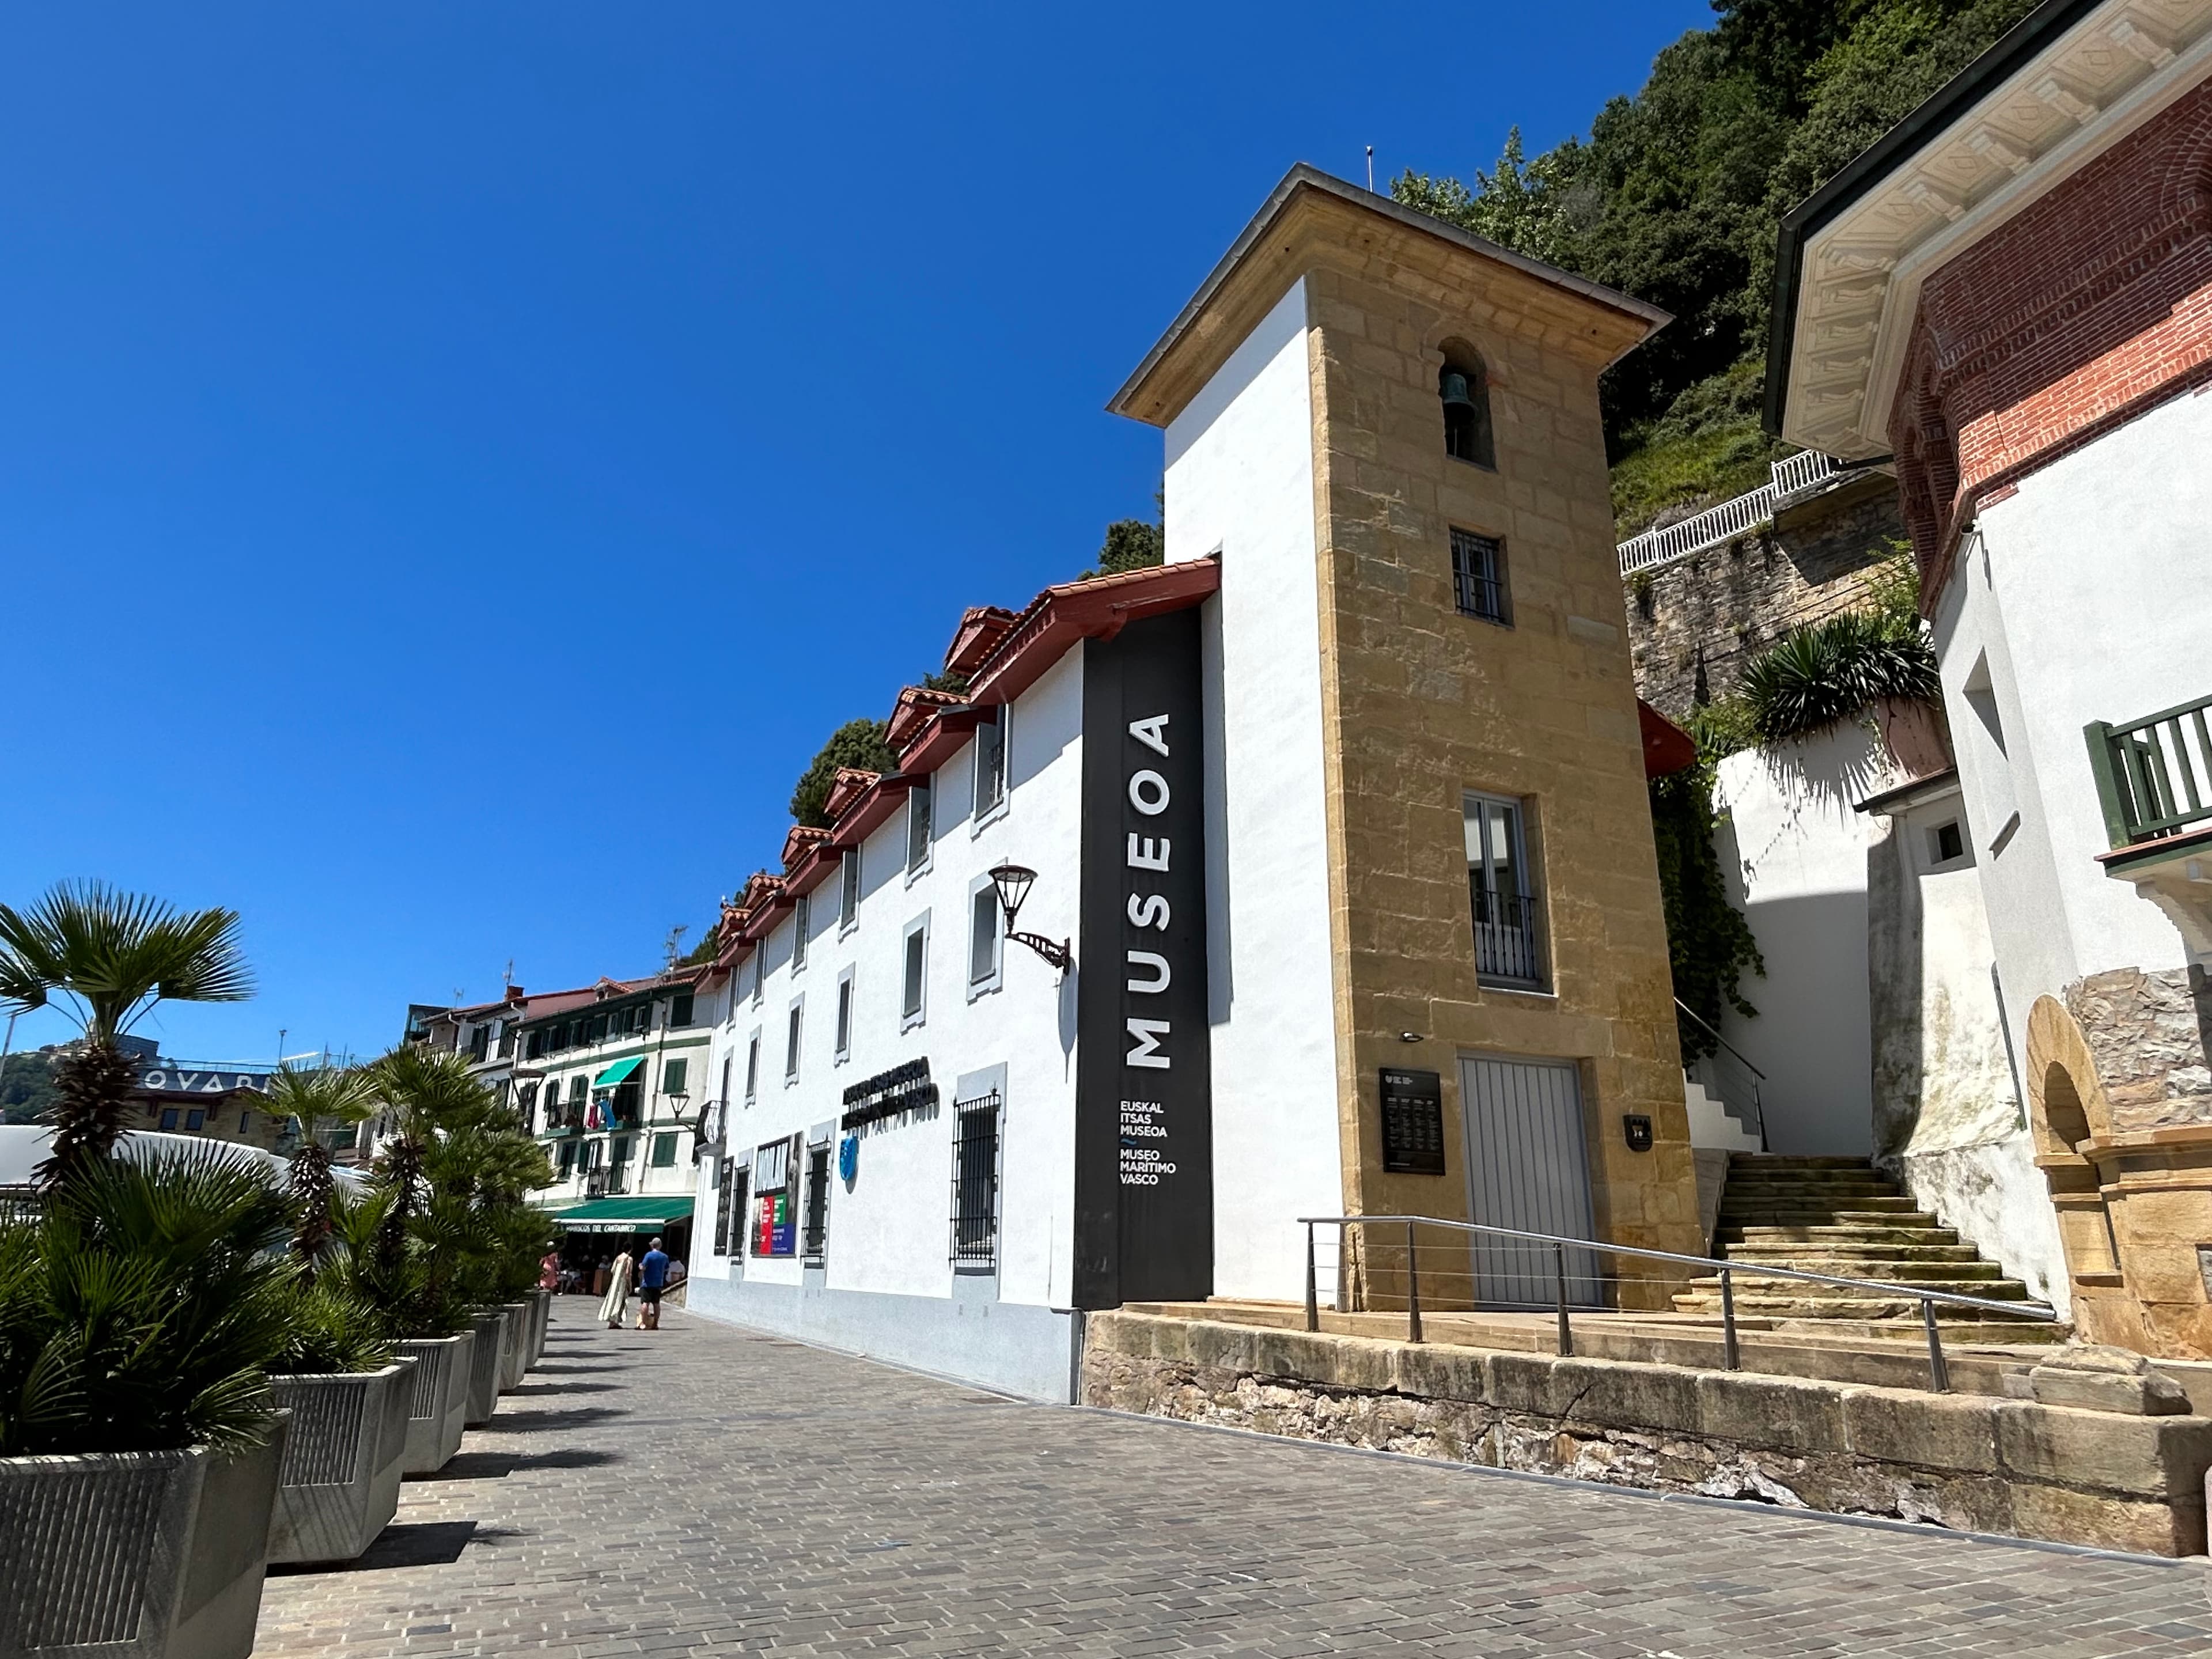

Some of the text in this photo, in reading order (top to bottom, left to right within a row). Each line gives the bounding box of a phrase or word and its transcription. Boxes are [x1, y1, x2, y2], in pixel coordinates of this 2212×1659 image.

[1127, 713, 1171, 1069] MUSEOA
[1120, 1100, 1165, 1113] EUSKAL
[1120, 1112, 1152, 1124] ITSAS
[1120, 1124, 1168, 1138] MUSEOA
[1120, 1149, 1160, 1161] MUSEO
[1120, 1159, 1176, 1173] MARÍTIMO
[1120, 1173, 1159, 1185] VASCO
